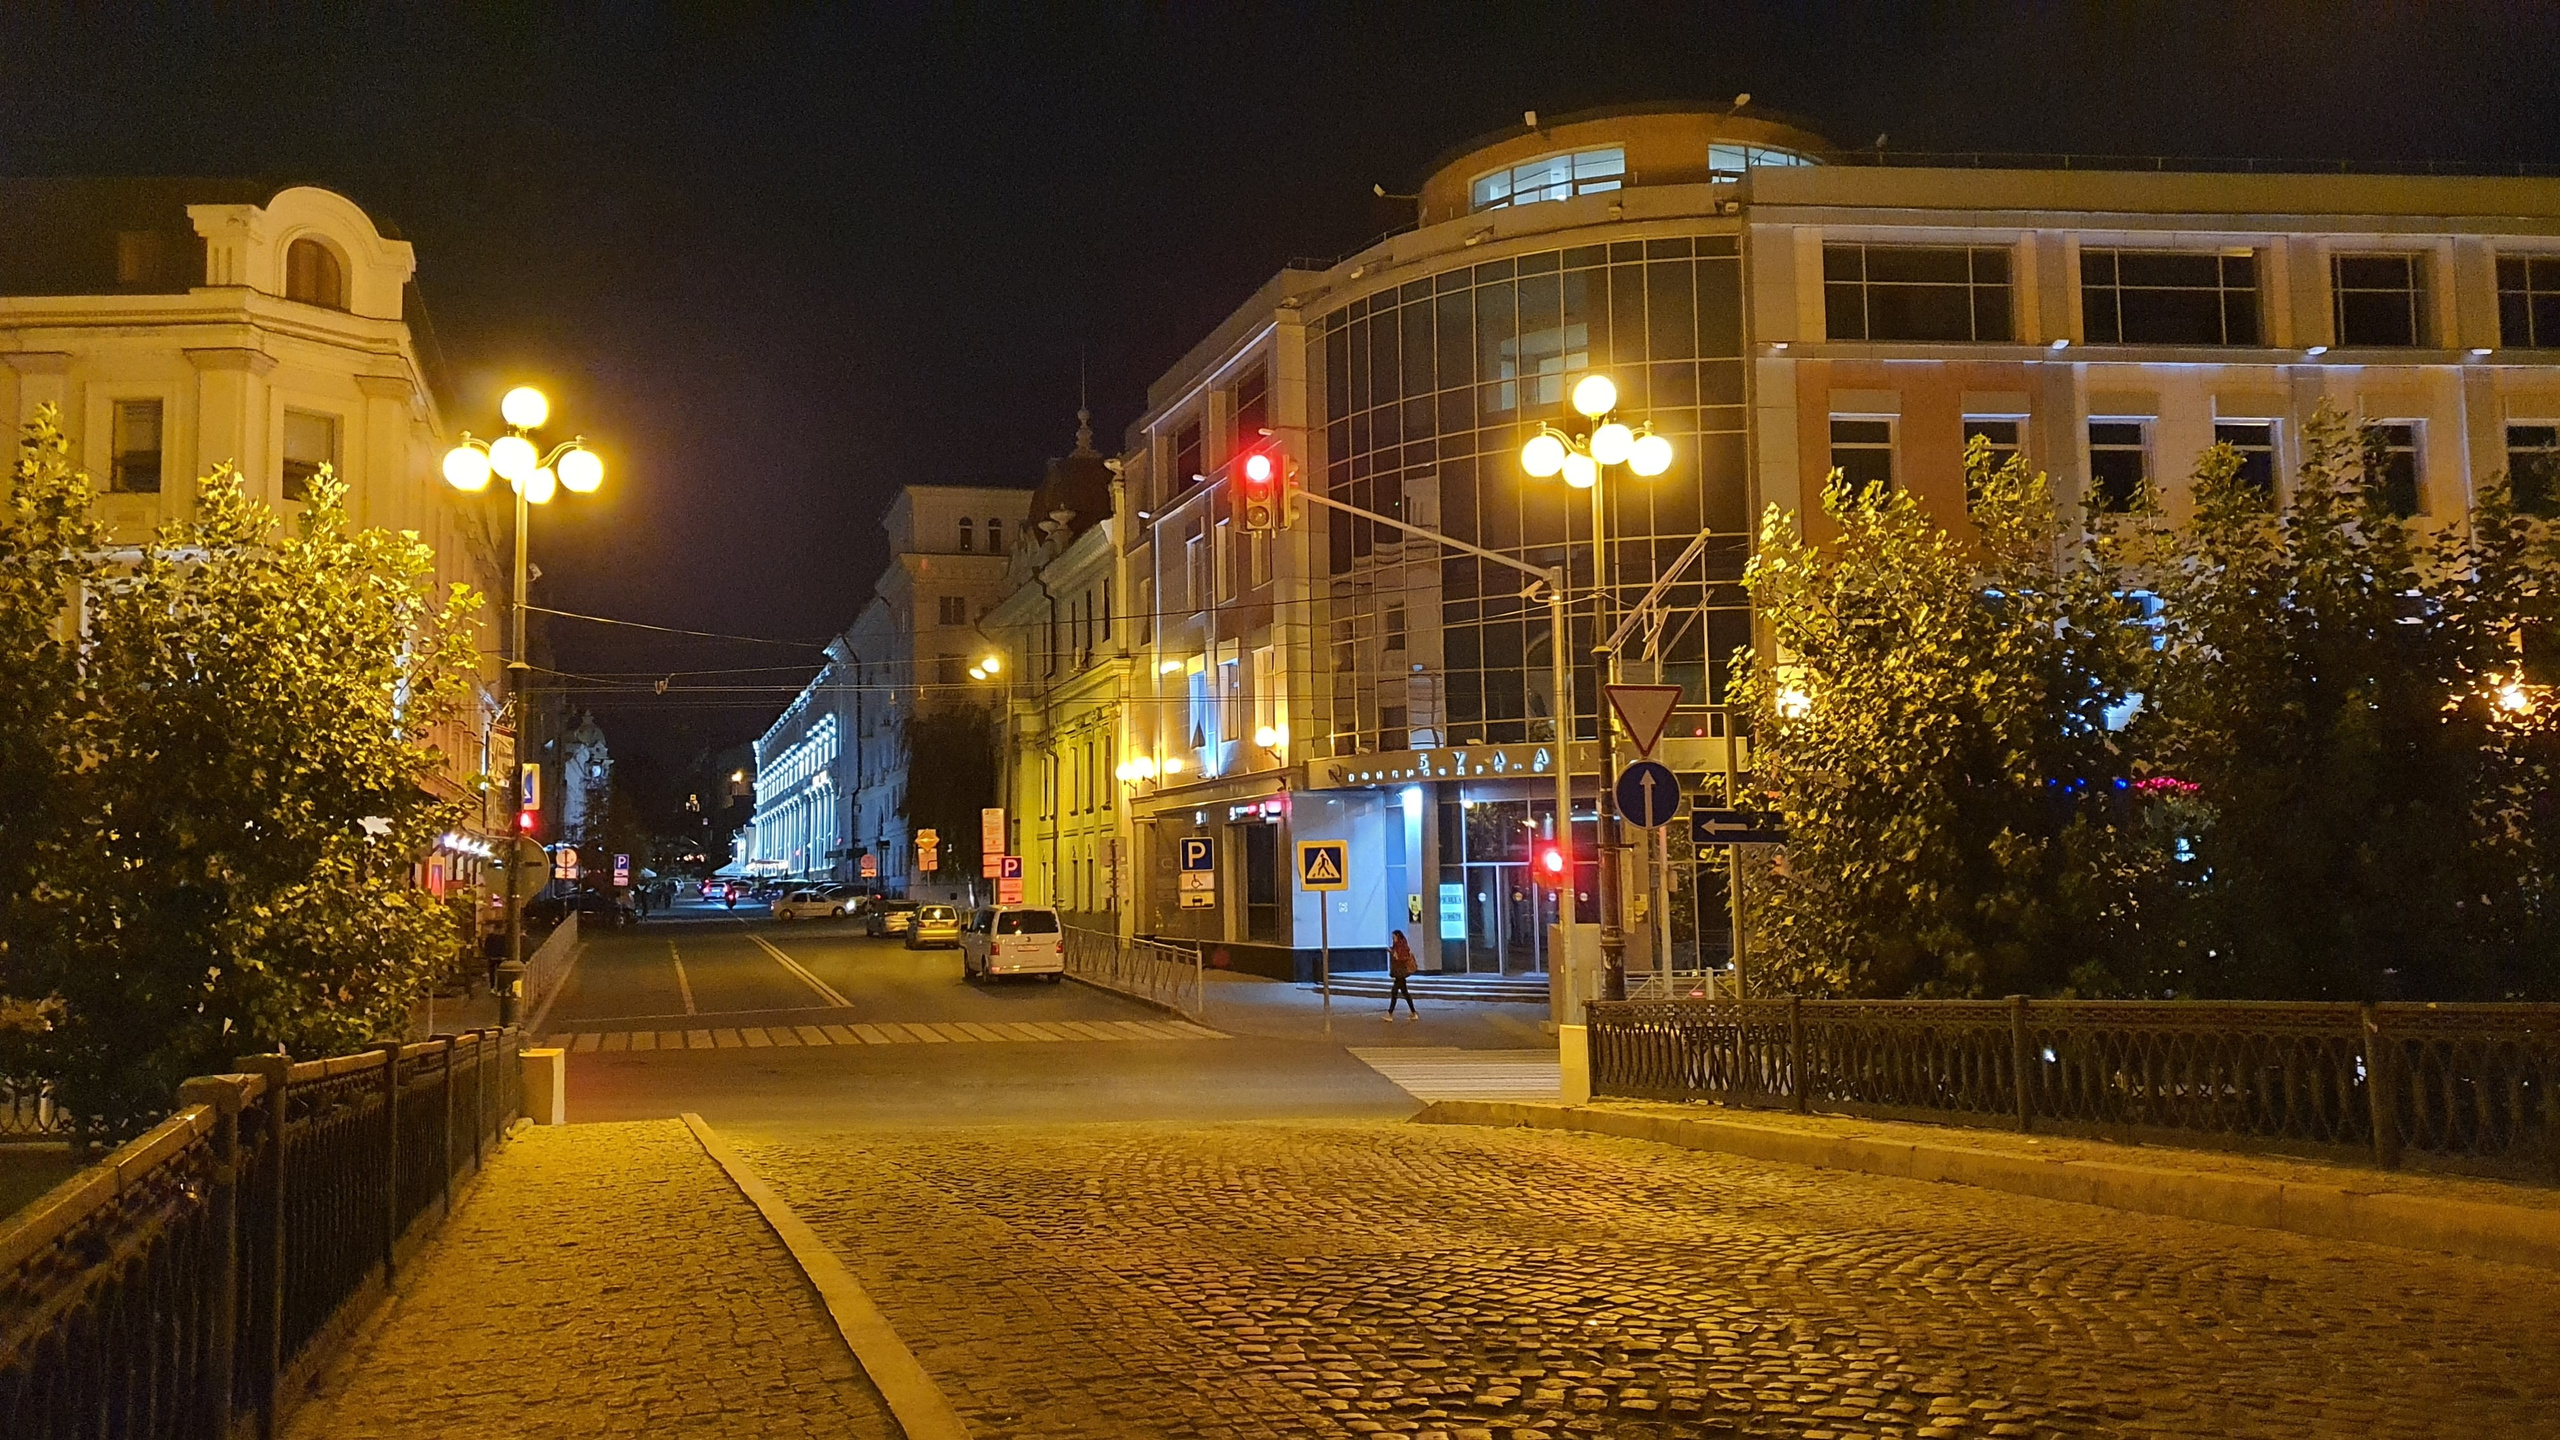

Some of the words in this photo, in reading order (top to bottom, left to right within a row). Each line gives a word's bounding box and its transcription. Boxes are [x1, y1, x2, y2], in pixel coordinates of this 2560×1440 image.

[617, 856, 627, 868] P
[1188, 841, 1206, 868] P
[1004, 858, 1018, 877] P
